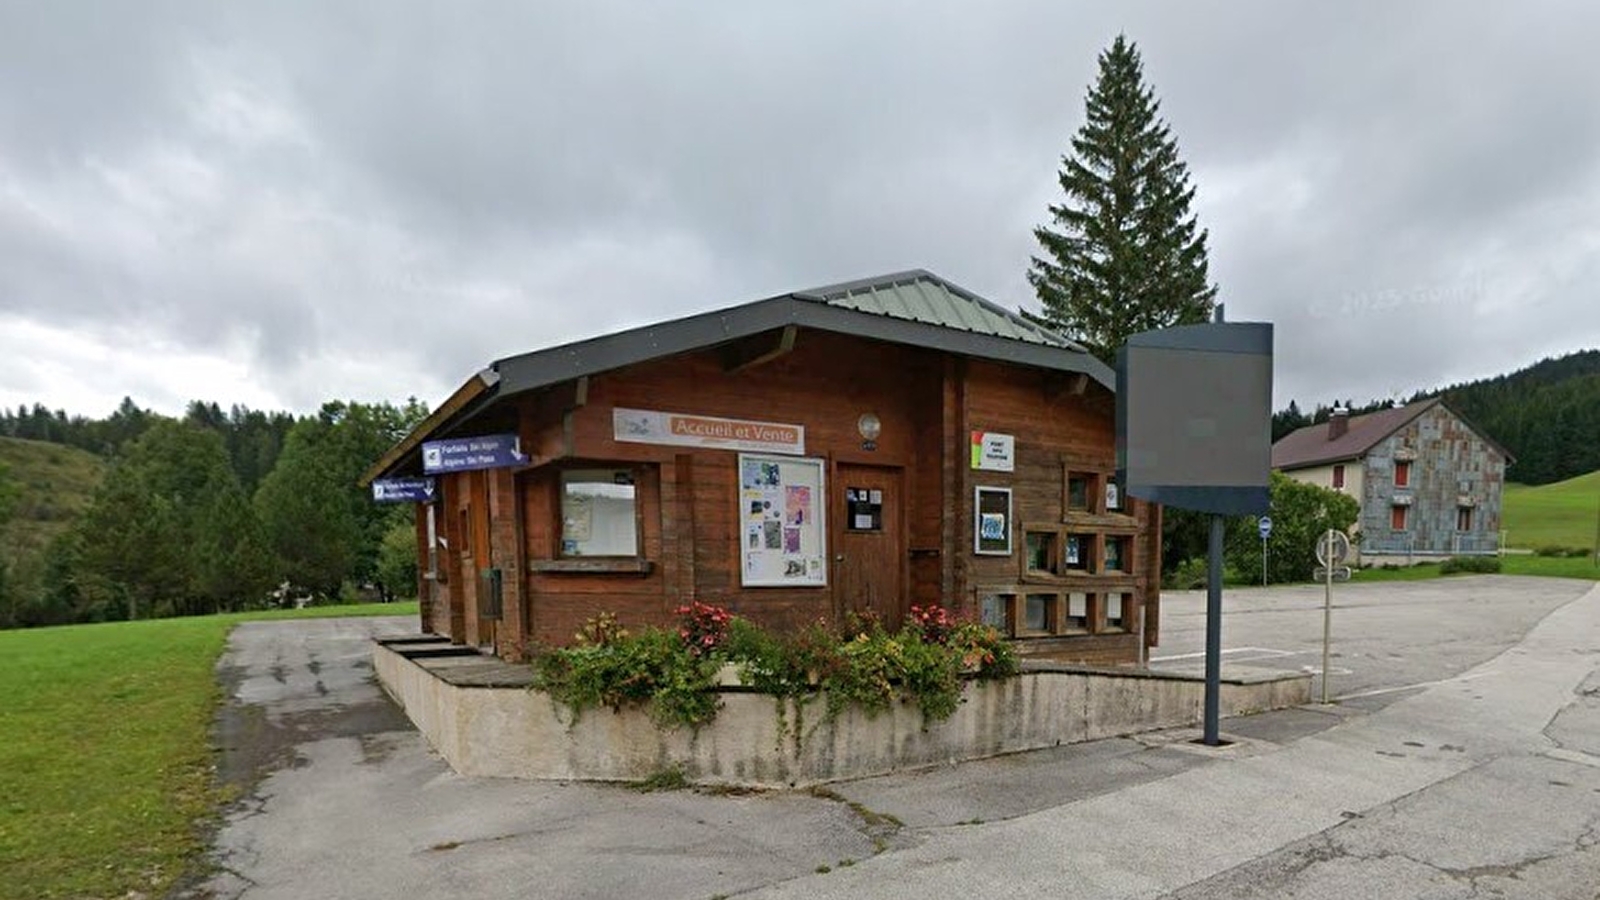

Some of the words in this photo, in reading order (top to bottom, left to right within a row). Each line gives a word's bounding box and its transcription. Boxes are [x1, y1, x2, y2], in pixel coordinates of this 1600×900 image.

[676, 419, 733, 438] Accueil
[735, 429, 750, 439] et
[752, 426, 794, 443] Vente
